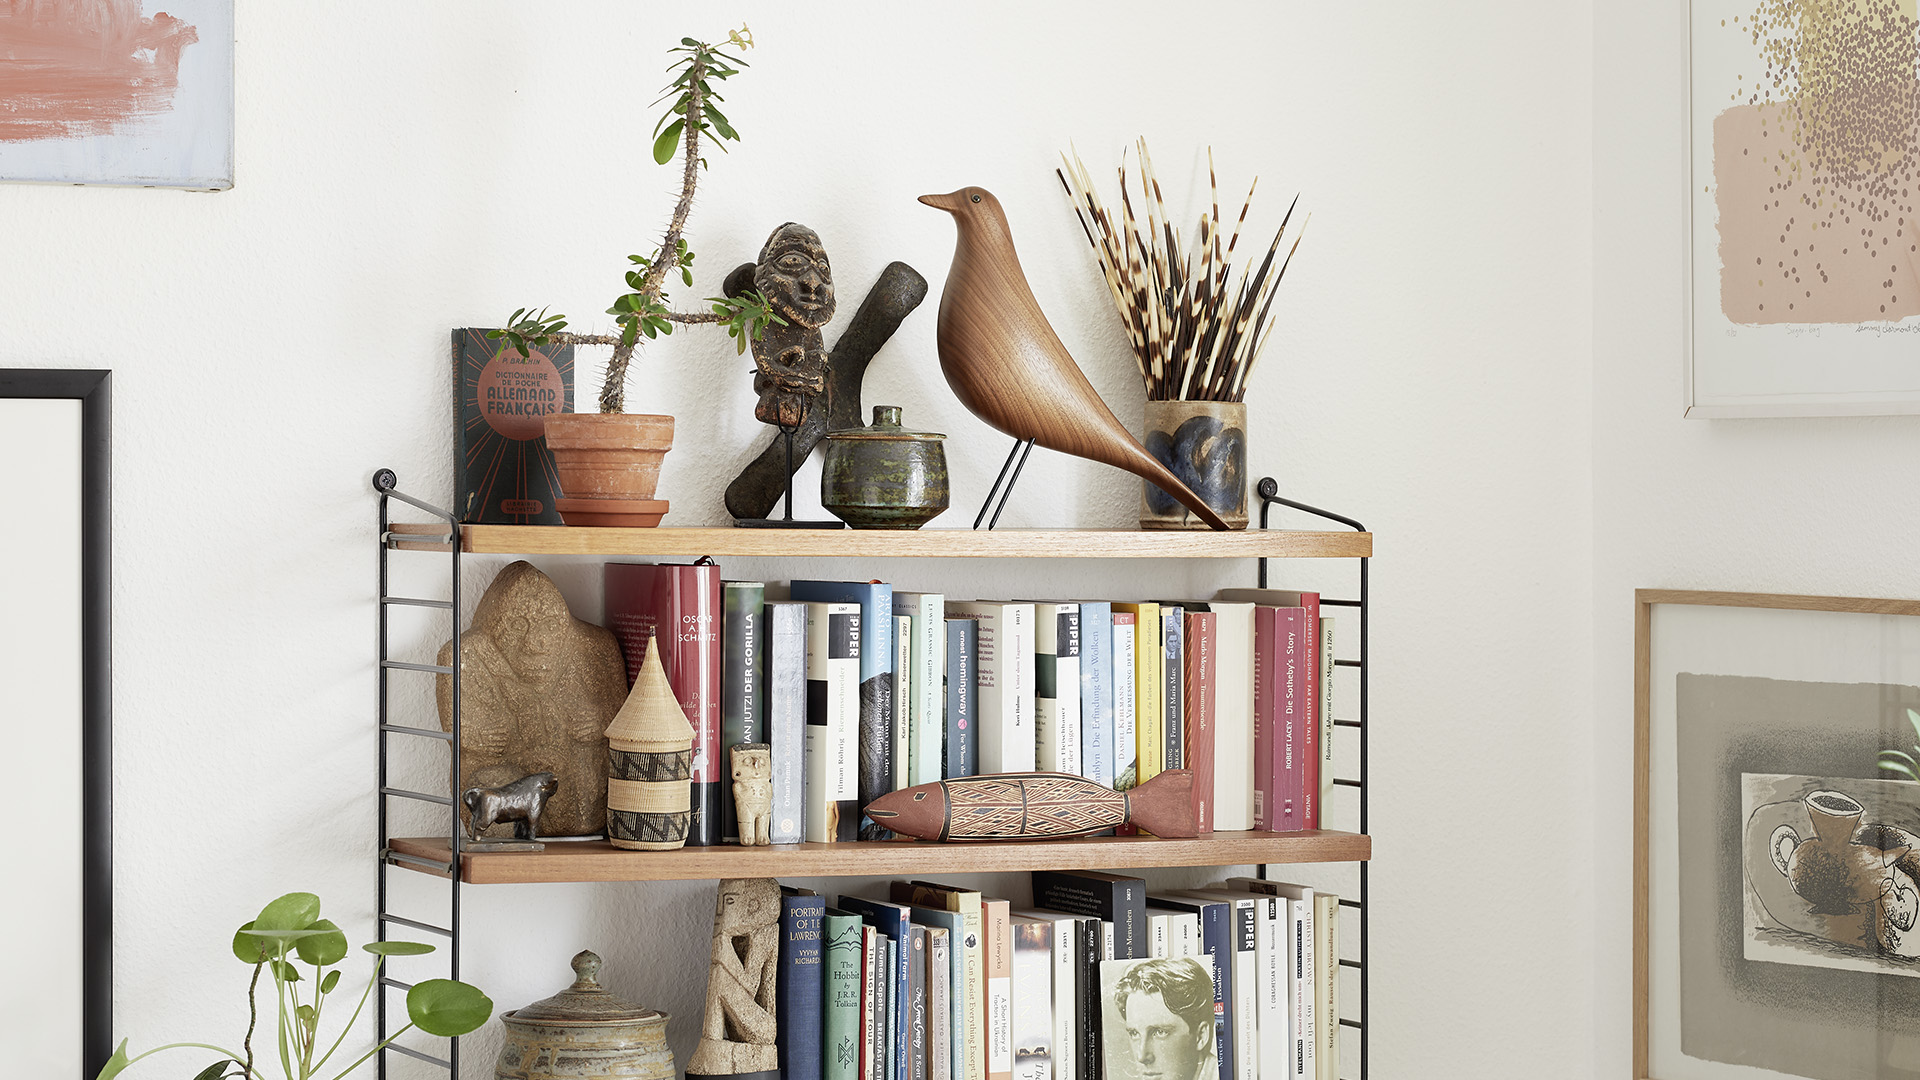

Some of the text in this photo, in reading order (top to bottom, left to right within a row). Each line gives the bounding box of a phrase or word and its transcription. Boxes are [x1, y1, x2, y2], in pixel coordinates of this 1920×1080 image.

[496, 371, 548, 381] DICTIONNAIRE
[487, 386, 556, 402] ALLEMAND
[487, 401, 555, 419] FRANÇAIS
[1308, 605, 1312, 613] W.
[850, 618, 859, 657] PIPER
[1069, 617, 1079, 656] PIPER
[1287, 632, 1296, 655] Story
[1091, 631, 1100, 665] Wolken
[744, 613, 754, 723] JUTZI DER GORILLA
[1091, 668, 1100, 683] der
[958, 655, 968, 716] hemingway
[1286, 658, 1296, 699] Sotheby's
[876, 690, 884, 723] schönen
[1091, 684, 1102, 730] Erfindung
[1286, 699, 1294, 714] Die
[1092, 732, 1101, 748] Die
[837, 734, 845, 765] Röhrig
[790, 907, 824, 918] PORTRAIT
[796, 919, 809, 929] OF
[1125, 909, 1133, 946] Menschen
[1244, 911, 1255, 949] PIPER
[794, 957, 821, 965] RICHARDS
[840, 961, 854, 969] The
[995, 942, 1003, 970] Lewycka
[834, 971, 860, 980] Hobbit
[834, 1000, 858, 1008] Tolkien
[837, 991, 857, 1000] J.R.R.
[915, 987, 923, 1004] The
[1017, 963, 1033, 1031] EVANS
[867, 1001, 873, 1014] OF
[912, 1000, 925, 1025] Great
[1306, 1004, 1312, 1019] my
[968, 1002, 976, 1044] Everything
[912, 1021, 925, 1049] Gatsby
[1002, 1045, 1008, 1053] of
[969, 1045, 977, 1072] Except
[876, 1064, 882, 1073] AT
